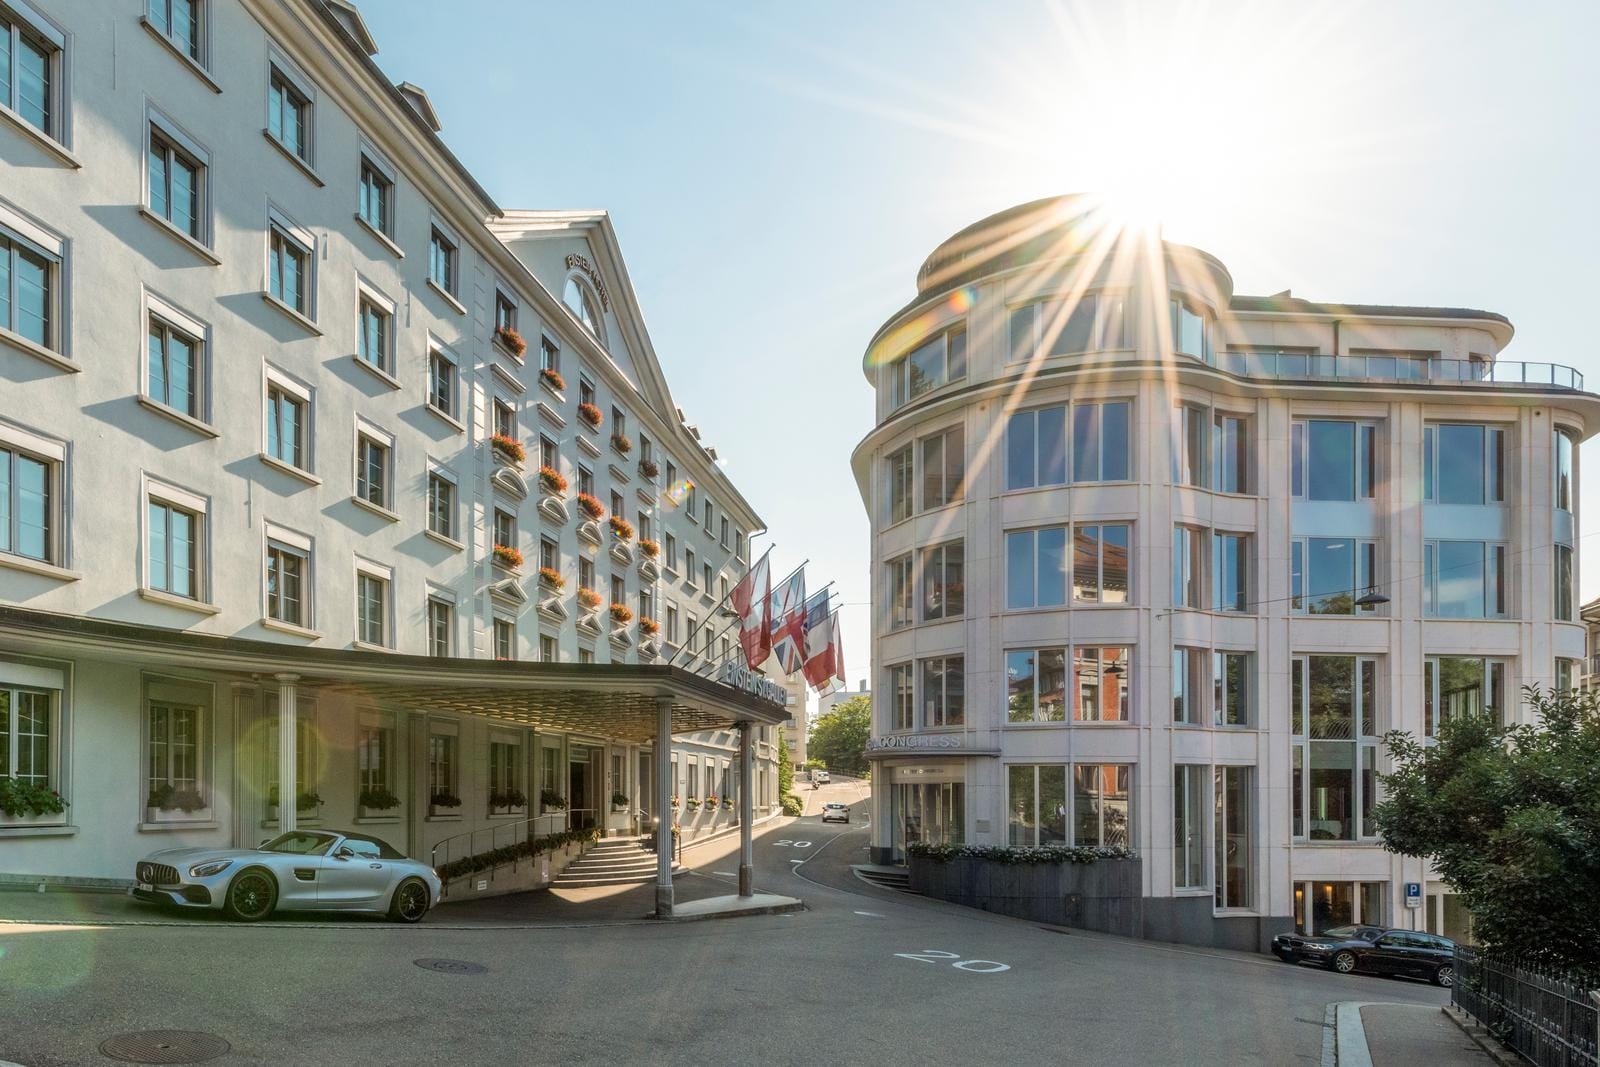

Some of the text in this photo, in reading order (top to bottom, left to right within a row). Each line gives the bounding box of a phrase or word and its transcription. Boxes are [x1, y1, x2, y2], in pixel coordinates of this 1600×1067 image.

[880, 735, 961, 748] CONGRESS
[772, 839, 812, 848] 20
[1410, 884, 1418, 896] P
[893, 949, 1011, 973] 20
